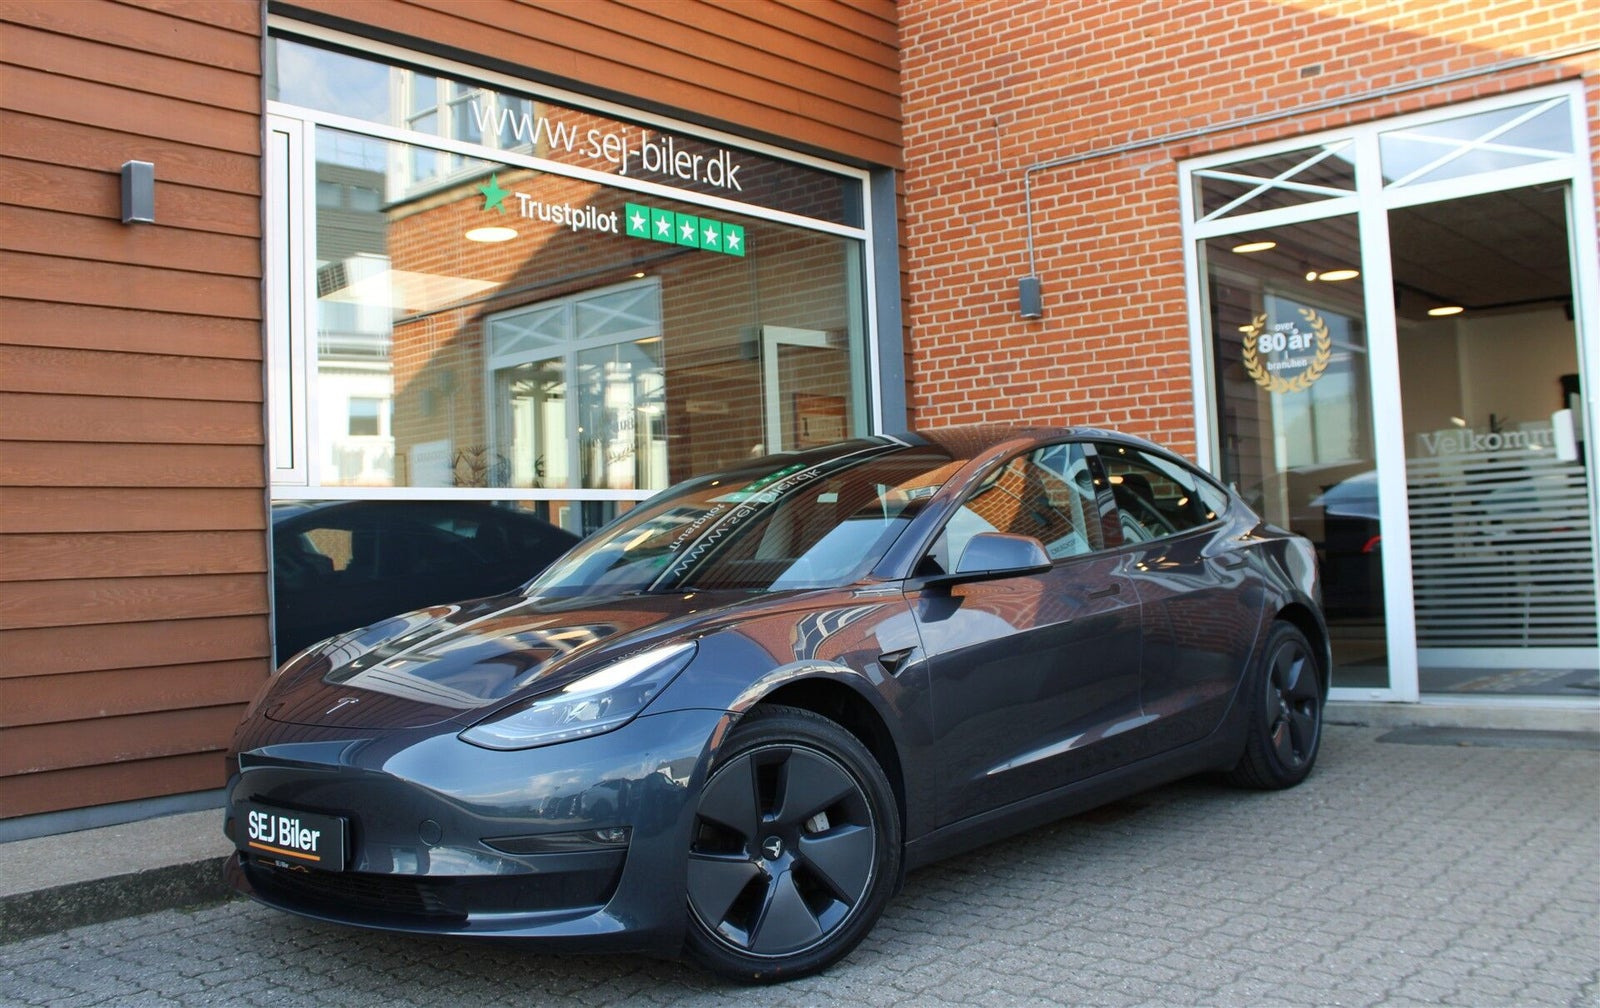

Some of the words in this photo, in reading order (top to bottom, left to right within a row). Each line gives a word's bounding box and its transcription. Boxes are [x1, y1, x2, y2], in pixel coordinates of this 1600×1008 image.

[472, 100, 743, 191] www.sej-biler.dk
[515, 192, 618, 234] Trustpilot
[1258, 332, 1287, 353] 80
[1288, 328, 1313, 350] år
[1275, 321, 1295, 332] over
[248, 810, 275, 843] SEJ
[279, 816, 321, 852] Biler
